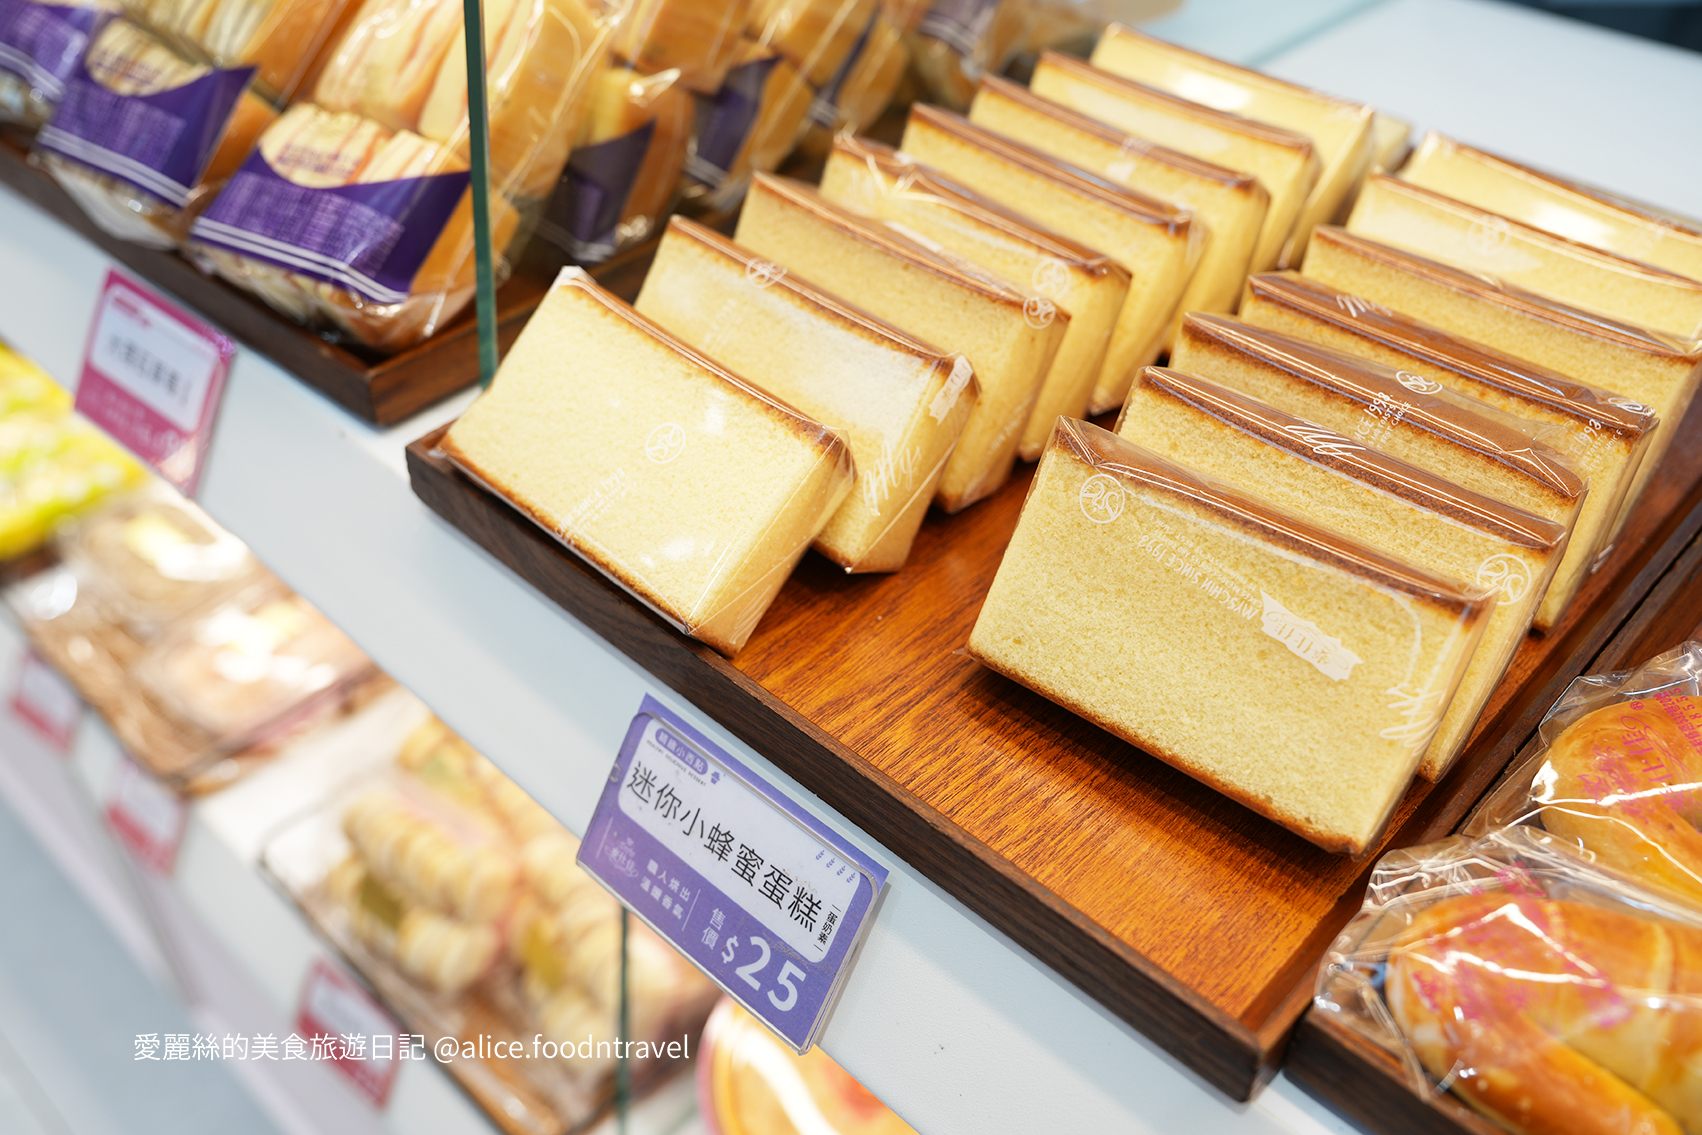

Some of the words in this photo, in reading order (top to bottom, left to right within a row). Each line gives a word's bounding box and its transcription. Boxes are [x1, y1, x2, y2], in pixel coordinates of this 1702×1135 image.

[573, 487, 603, 516] SINCE
[1165, 553, 1200, 583] SINCE
[1176, 545, 1191, 558] AND
[1200, 577, 1259, 621] MYSCHIN
[626, 760, 823, 932] 迷你小蜂蜜蛋糕
[701, 906, 727, 951] 售價
[721, 935, 807, 1012] $25
